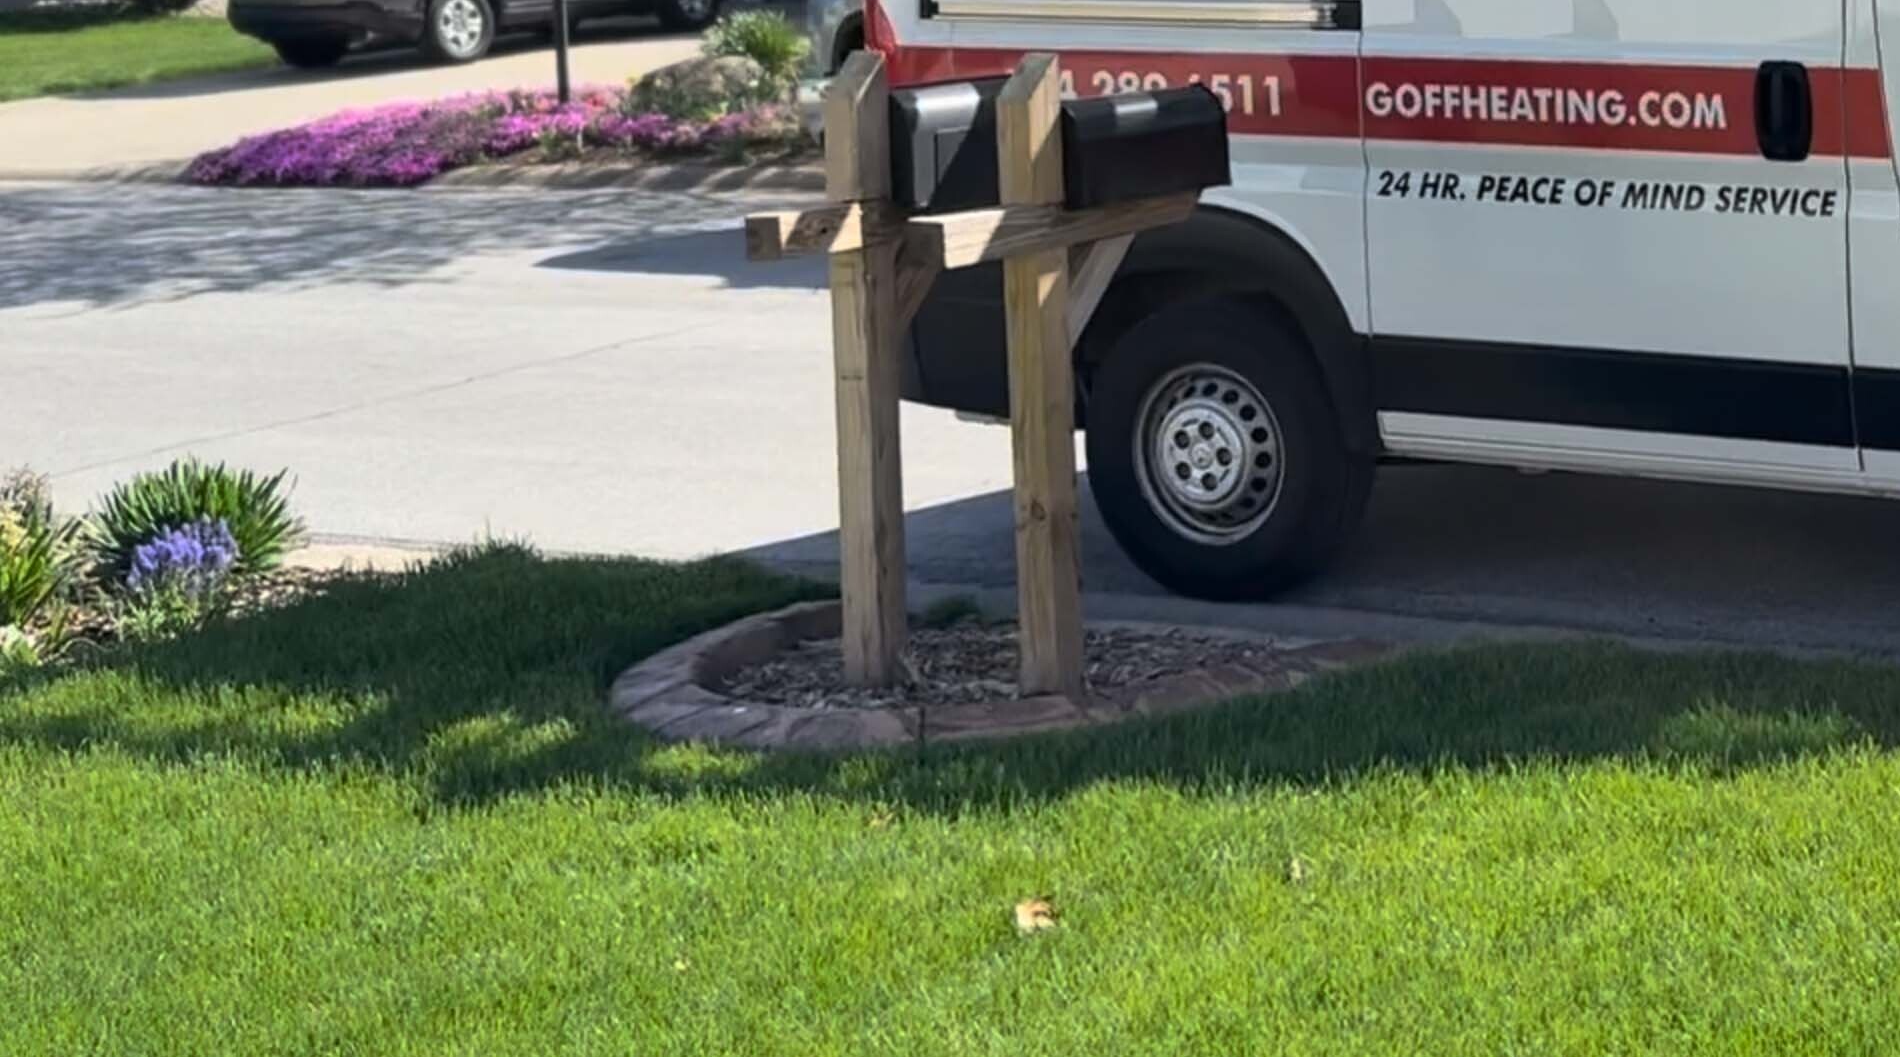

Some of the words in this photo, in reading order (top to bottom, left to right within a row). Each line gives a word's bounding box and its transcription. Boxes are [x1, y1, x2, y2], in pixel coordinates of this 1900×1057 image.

[1187, 73, 1281, 116] 511
[1365, 82, 1727, 130] GOFFHEATING.COM
[1377, 171, 1411, 198] 24
[1418, 173, 1466, 202] HR.
[1476, 175, 1566, 205] PEACE
[1573, 179, 1614, 207] OF
[1621, 181, 1707, 212] MIND
[1713, 185, 1838, 218] SERVICE
